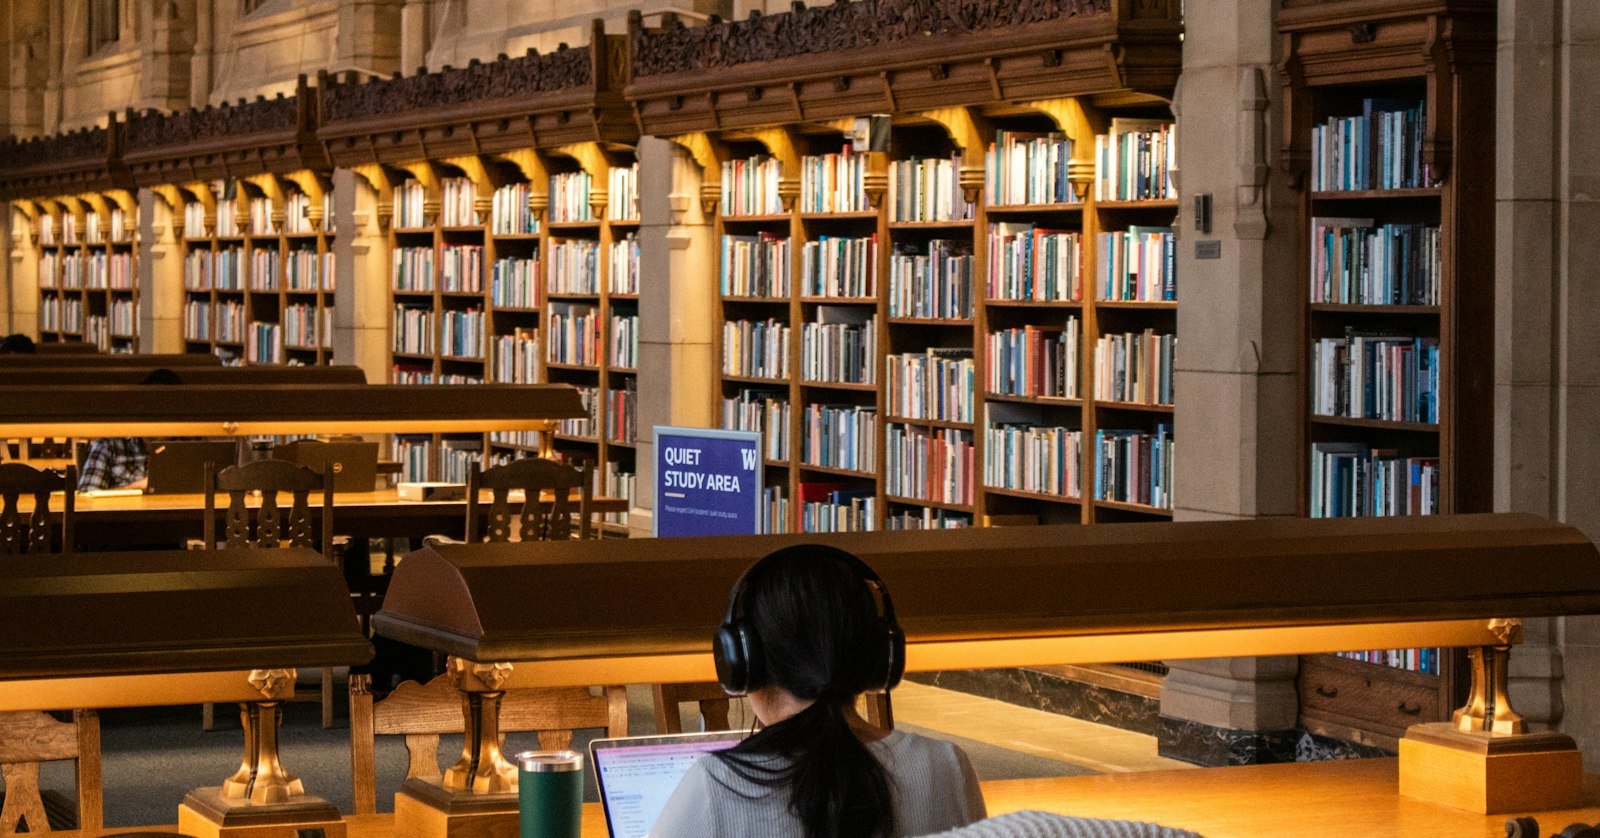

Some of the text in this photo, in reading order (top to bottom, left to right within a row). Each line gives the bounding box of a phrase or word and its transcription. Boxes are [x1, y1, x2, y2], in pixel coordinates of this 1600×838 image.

[665, 447, 701, 466] QUIET
[741, 448, 756, 470] W
[664, 470, 740, 492] STUDY AREA
